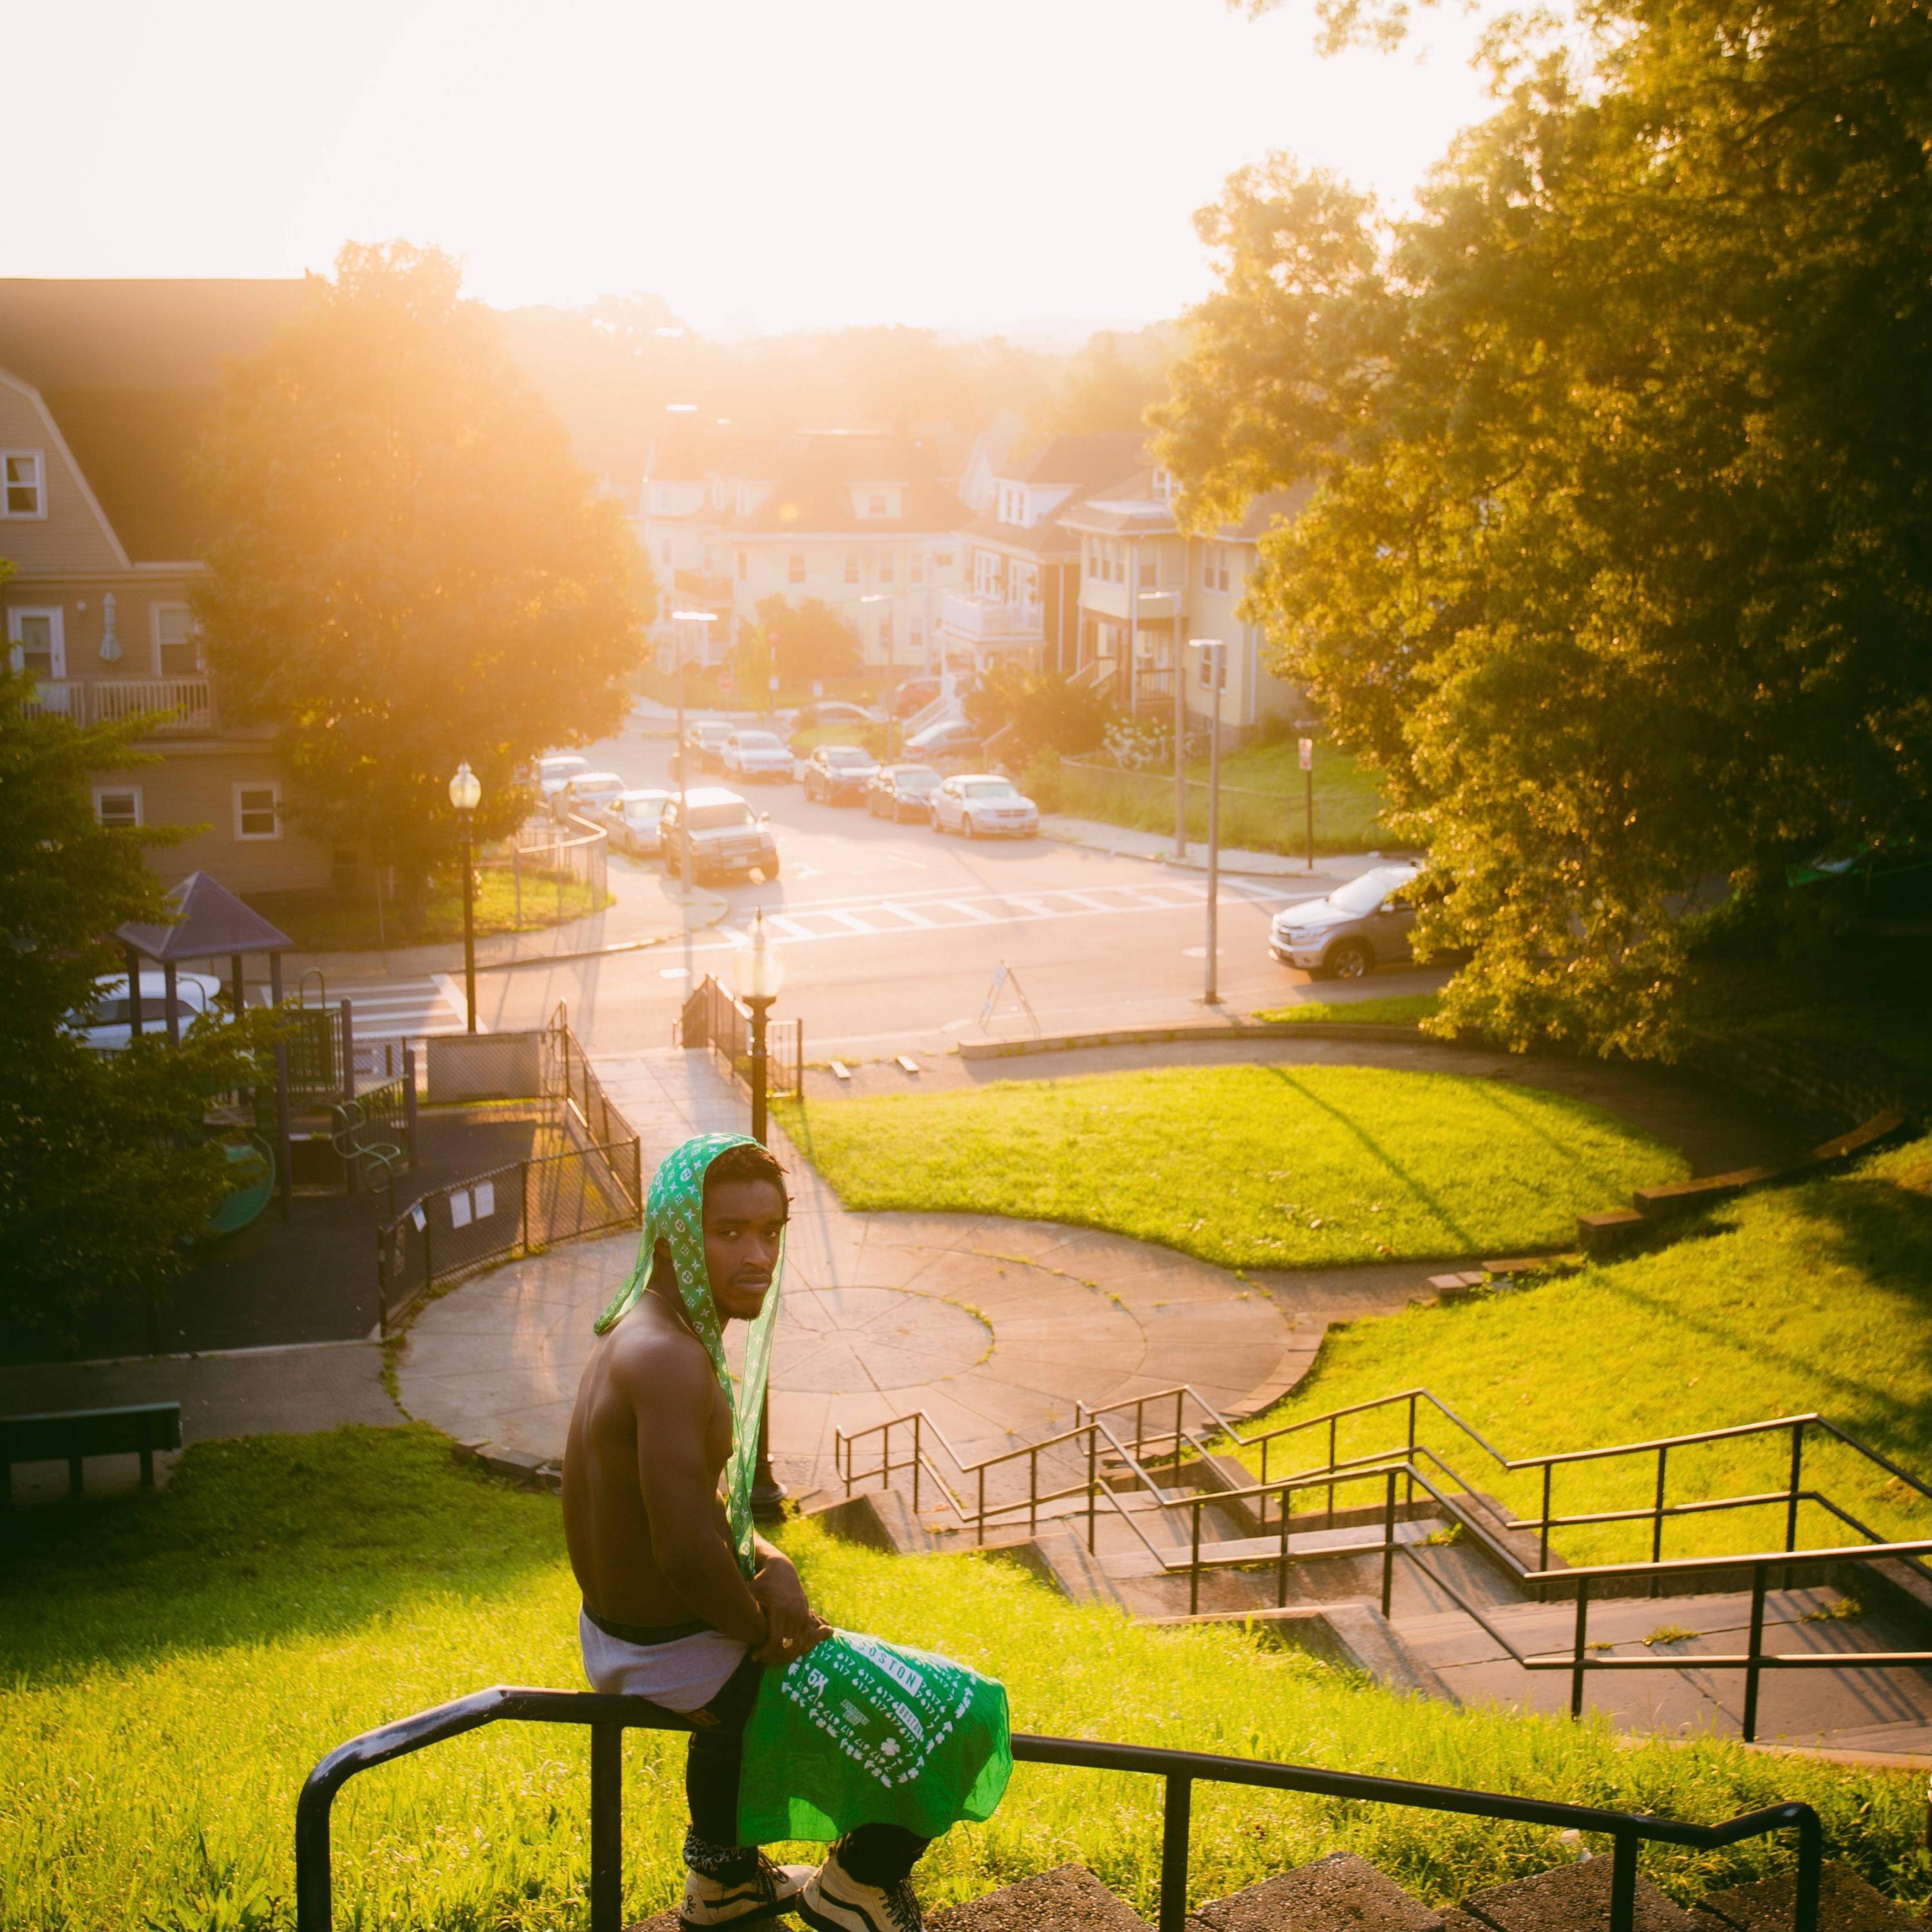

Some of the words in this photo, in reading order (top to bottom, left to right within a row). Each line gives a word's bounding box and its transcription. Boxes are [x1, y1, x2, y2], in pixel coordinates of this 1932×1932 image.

[837, 1653, 856, 1666] 617
[858, 1669, 876, 1684] 617
[876, 1686, 894, 1702] 617
[833, 1662, 851, 1676] 617
[852, 1678, 869, 1694] 617
[869, 1696, 887, 1711] 617
[885, 1712, 902, 1726] 617
[899, 1728, 915, 1743] 617
[920, 1698, 935, 1714] 617
[925, 1689, 941, 1705] 617
